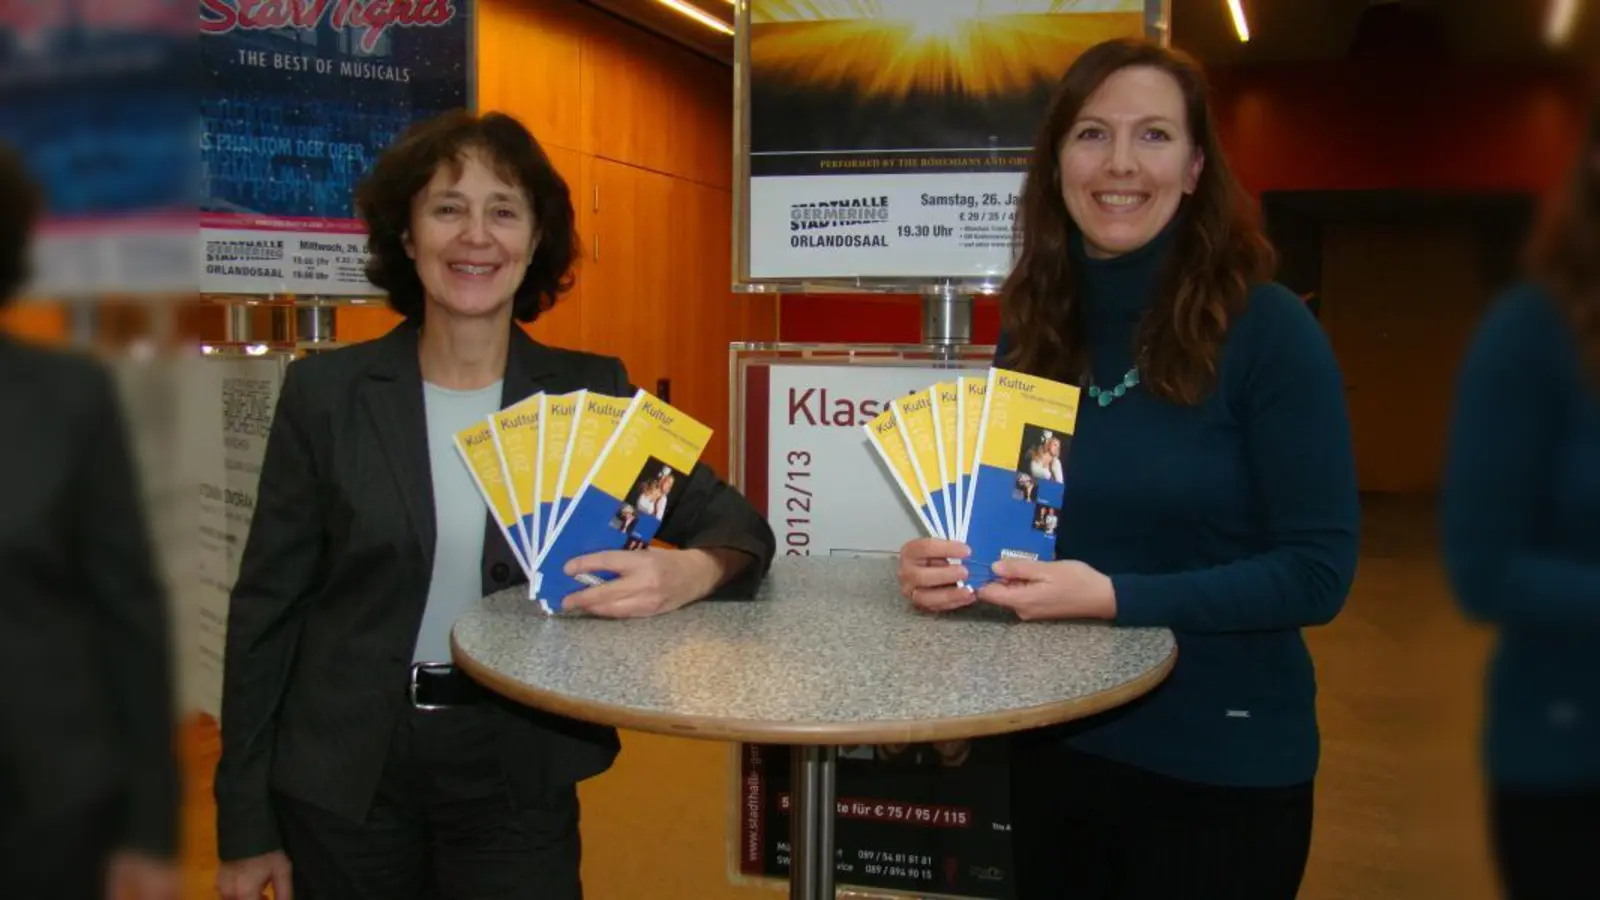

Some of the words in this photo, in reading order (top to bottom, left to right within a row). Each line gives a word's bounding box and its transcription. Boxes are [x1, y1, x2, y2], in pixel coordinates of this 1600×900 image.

[239, 50, 266, 67] THE
[274, 53, 308, 72] BEST
[316, 58, 333, 75] OF
[340, 61, 411, 84] MUSICALS
[216, 133, 292, 157] PHANTOM
[296, 139, 325, 157] DER
[328, 142, 366, 162] OPER
[820, 159, 880, 169] PERFORMED
[882, 159, 895, 168] BY
[899, 158, 918, 168] THE
[920, 192, 979, 209] Samstag,
[982, 192, 1002, 207] 26.
[791, 208, 889, 219] GERMERING
[897, 225, 930, 238] 19.30
[933, 224, 954, 238] Uhr
[300, 240, 345, 254] Mittwoch,
[791, 234, 889, 248] ORLANDOSAAL
[206, 264, 285, 279] ORLANDOSAAL
[999, 376, 1036, 393] Kultur
[642, 402, 674, 425] Kultur
[785, 450, 813, 557] 2012/13
[852, 803, 872, 815] für
[874, 805, 884, 817] €
[888, 806, 903, 819] 75
[905, 807, 913, 820] /
[915, 808, 931, 821] 95
[933, 809, 941, 823] /
[944, 810, 967, 824] 115
[836, 861, 854, 872] vice
